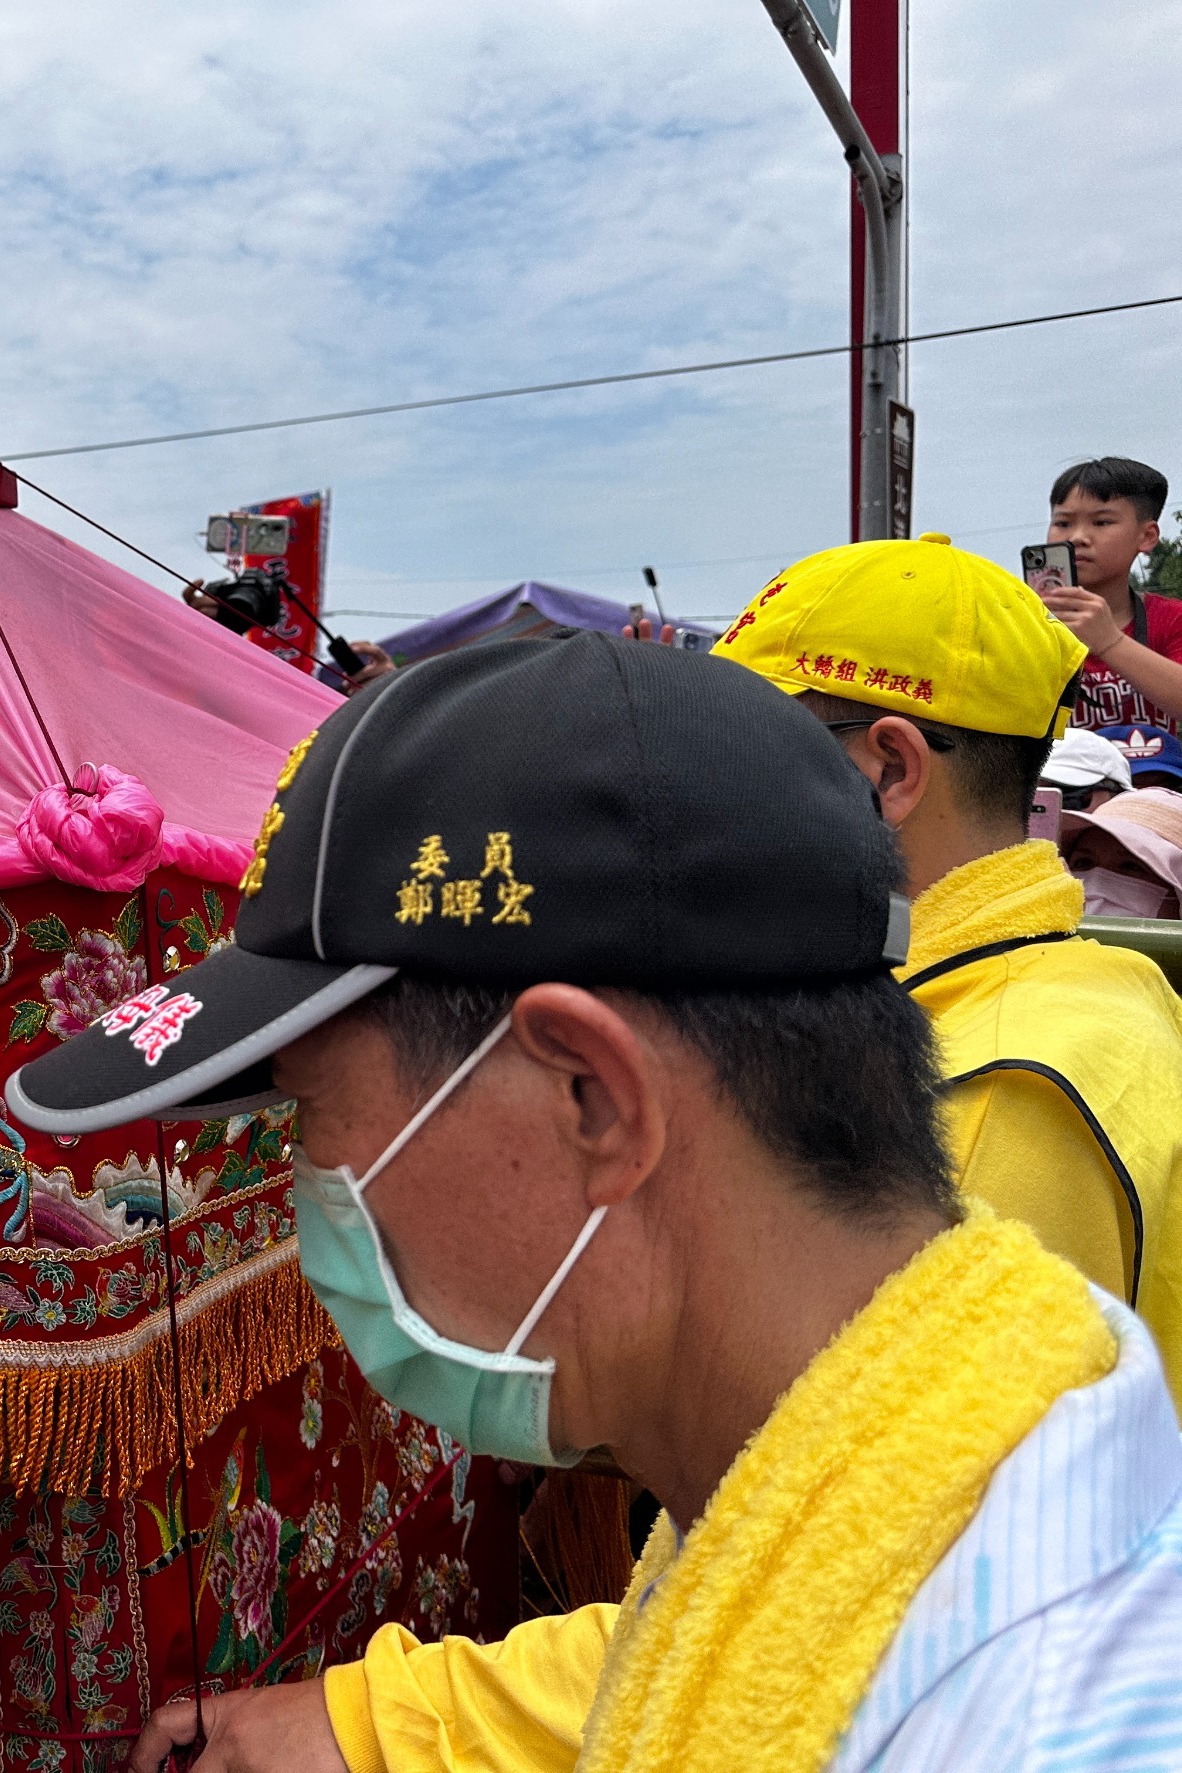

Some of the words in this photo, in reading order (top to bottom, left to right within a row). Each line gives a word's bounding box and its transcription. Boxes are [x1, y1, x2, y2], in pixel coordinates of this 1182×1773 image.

[863, 666, 933, 705] 洪政義
[409, 831, 515, 880] 委員
